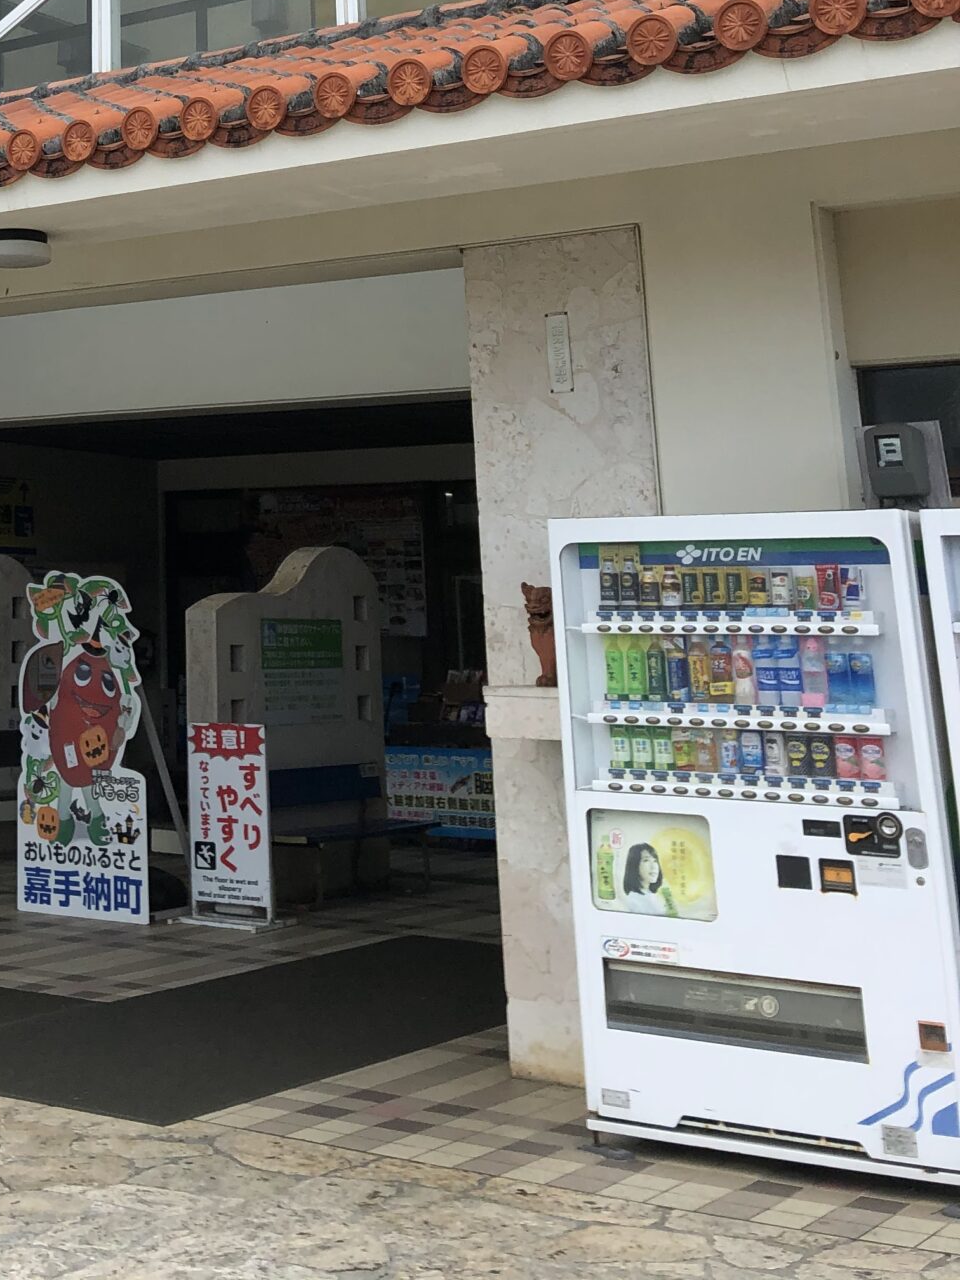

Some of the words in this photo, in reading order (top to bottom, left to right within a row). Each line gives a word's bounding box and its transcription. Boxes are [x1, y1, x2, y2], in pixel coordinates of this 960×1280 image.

[702, 547, 734, 562] ITO
[737, 547, 762, 562] EN
[201, 729, 246, 749] 注意!
[91, 783, 140, 803] いもっち
[199, 760, 210, 840] なっています
[239, 763, 263, 850] すべり
[216, 785, 239, 873] やすく
[24, 841, 142, 872] おいものふるさと
[24, 866, 143, 916] 嘉手納町
